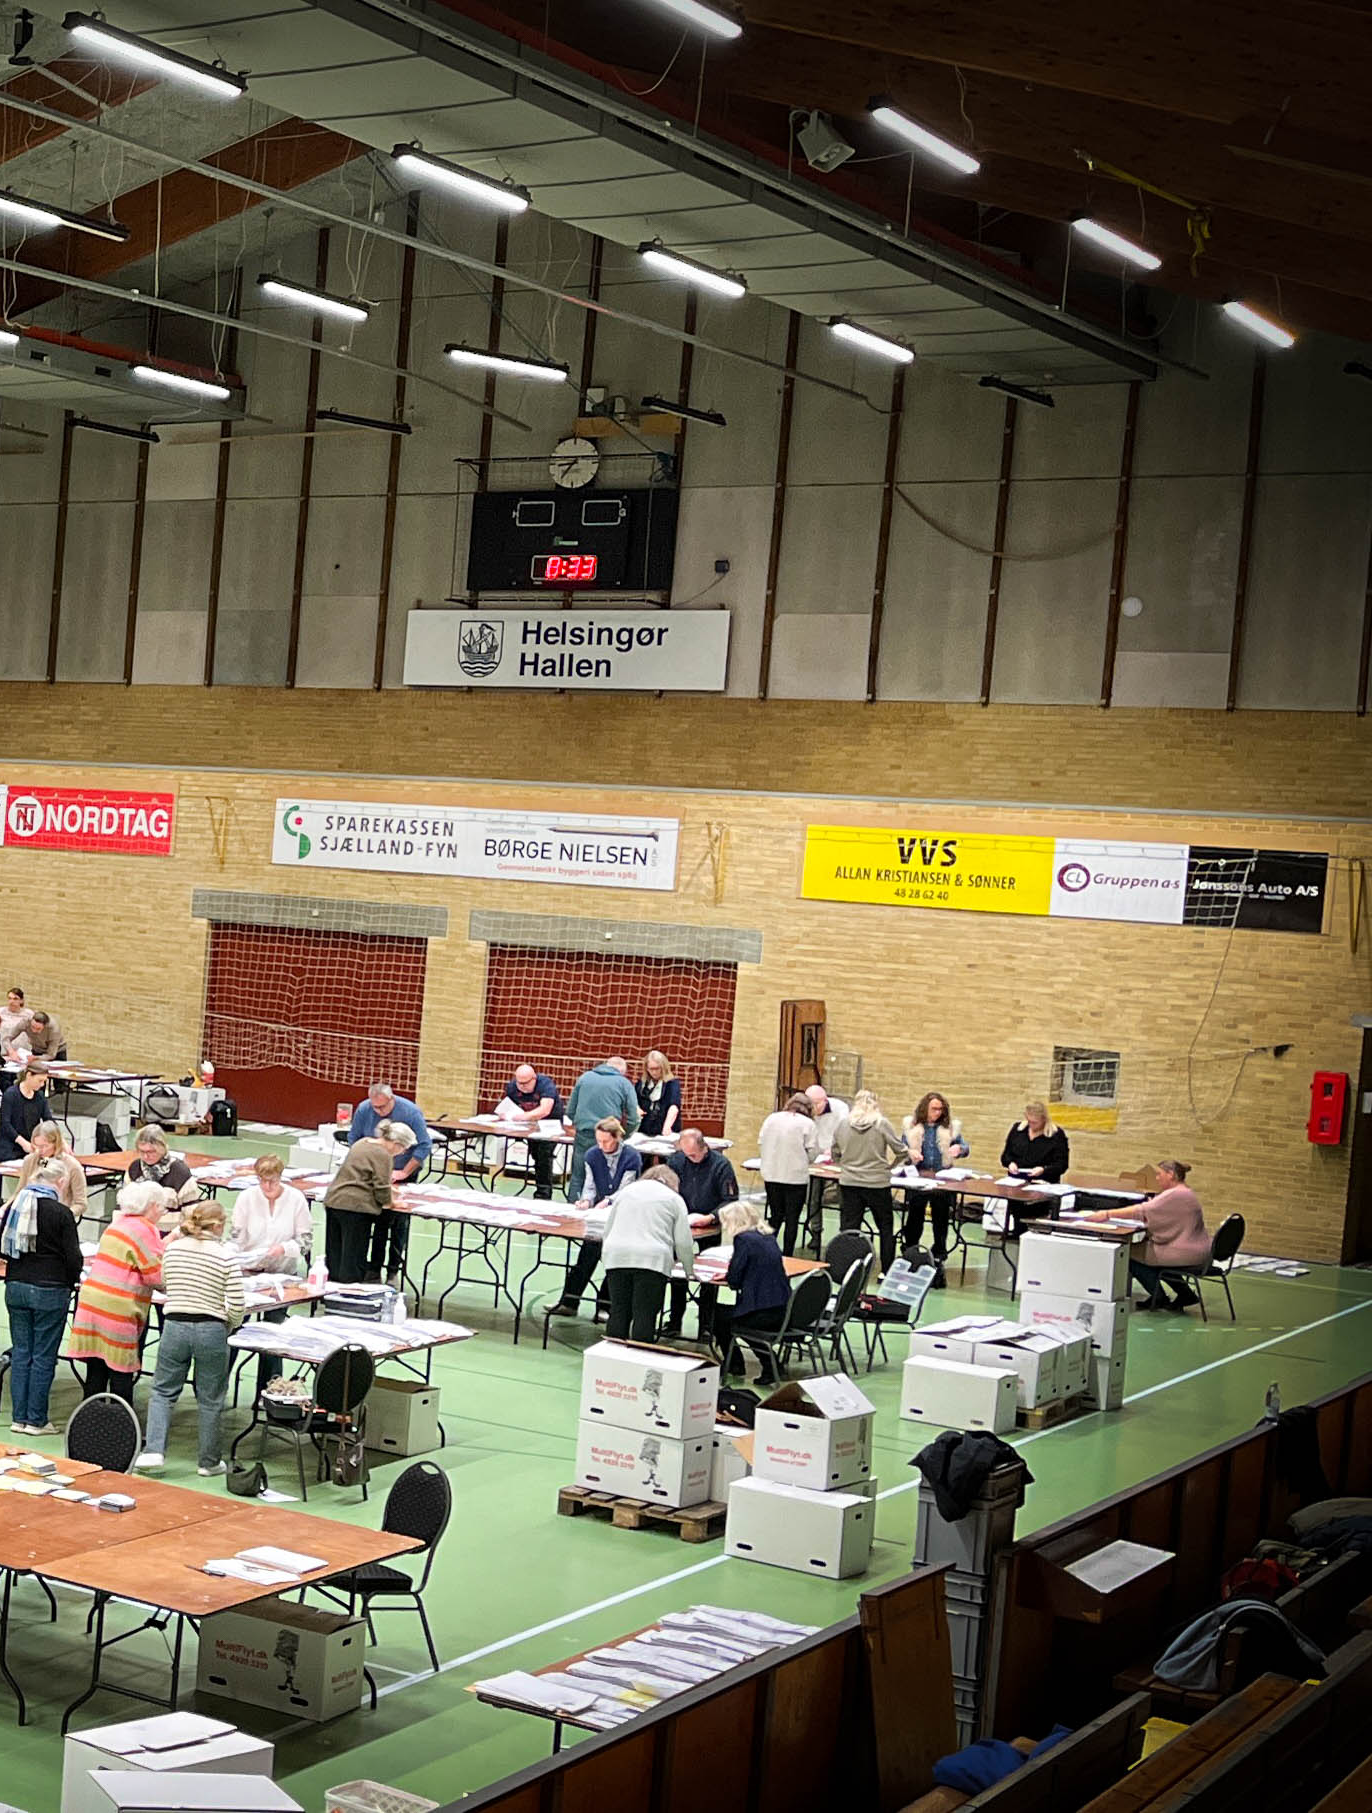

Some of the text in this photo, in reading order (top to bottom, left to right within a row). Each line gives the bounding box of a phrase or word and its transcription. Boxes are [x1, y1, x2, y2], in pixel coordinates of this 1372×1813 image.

[522, 620, 669, 652] Helsingør
[519, 652, 611, 677] Hallen
[45, 804, 169, 838] NORDTAG
[325, 815, 454, 837] SPAREKASSEN
[320, 836, 458, 859] SJÆLLAND-FYN
[484, 838, 648, 866] BØRGE NIELSEN
[897, 837, 957, 867] VVS
[835, 865, 1016, 890] ALLAN KRISTIANSEN & SØNNER
[1093, 873, 1159, 889] Gruppen
[1258, 883, 1292, 895] Auto
[1295, 885, 1319, 897] A/S
[936, 890, 949, 900] 40
